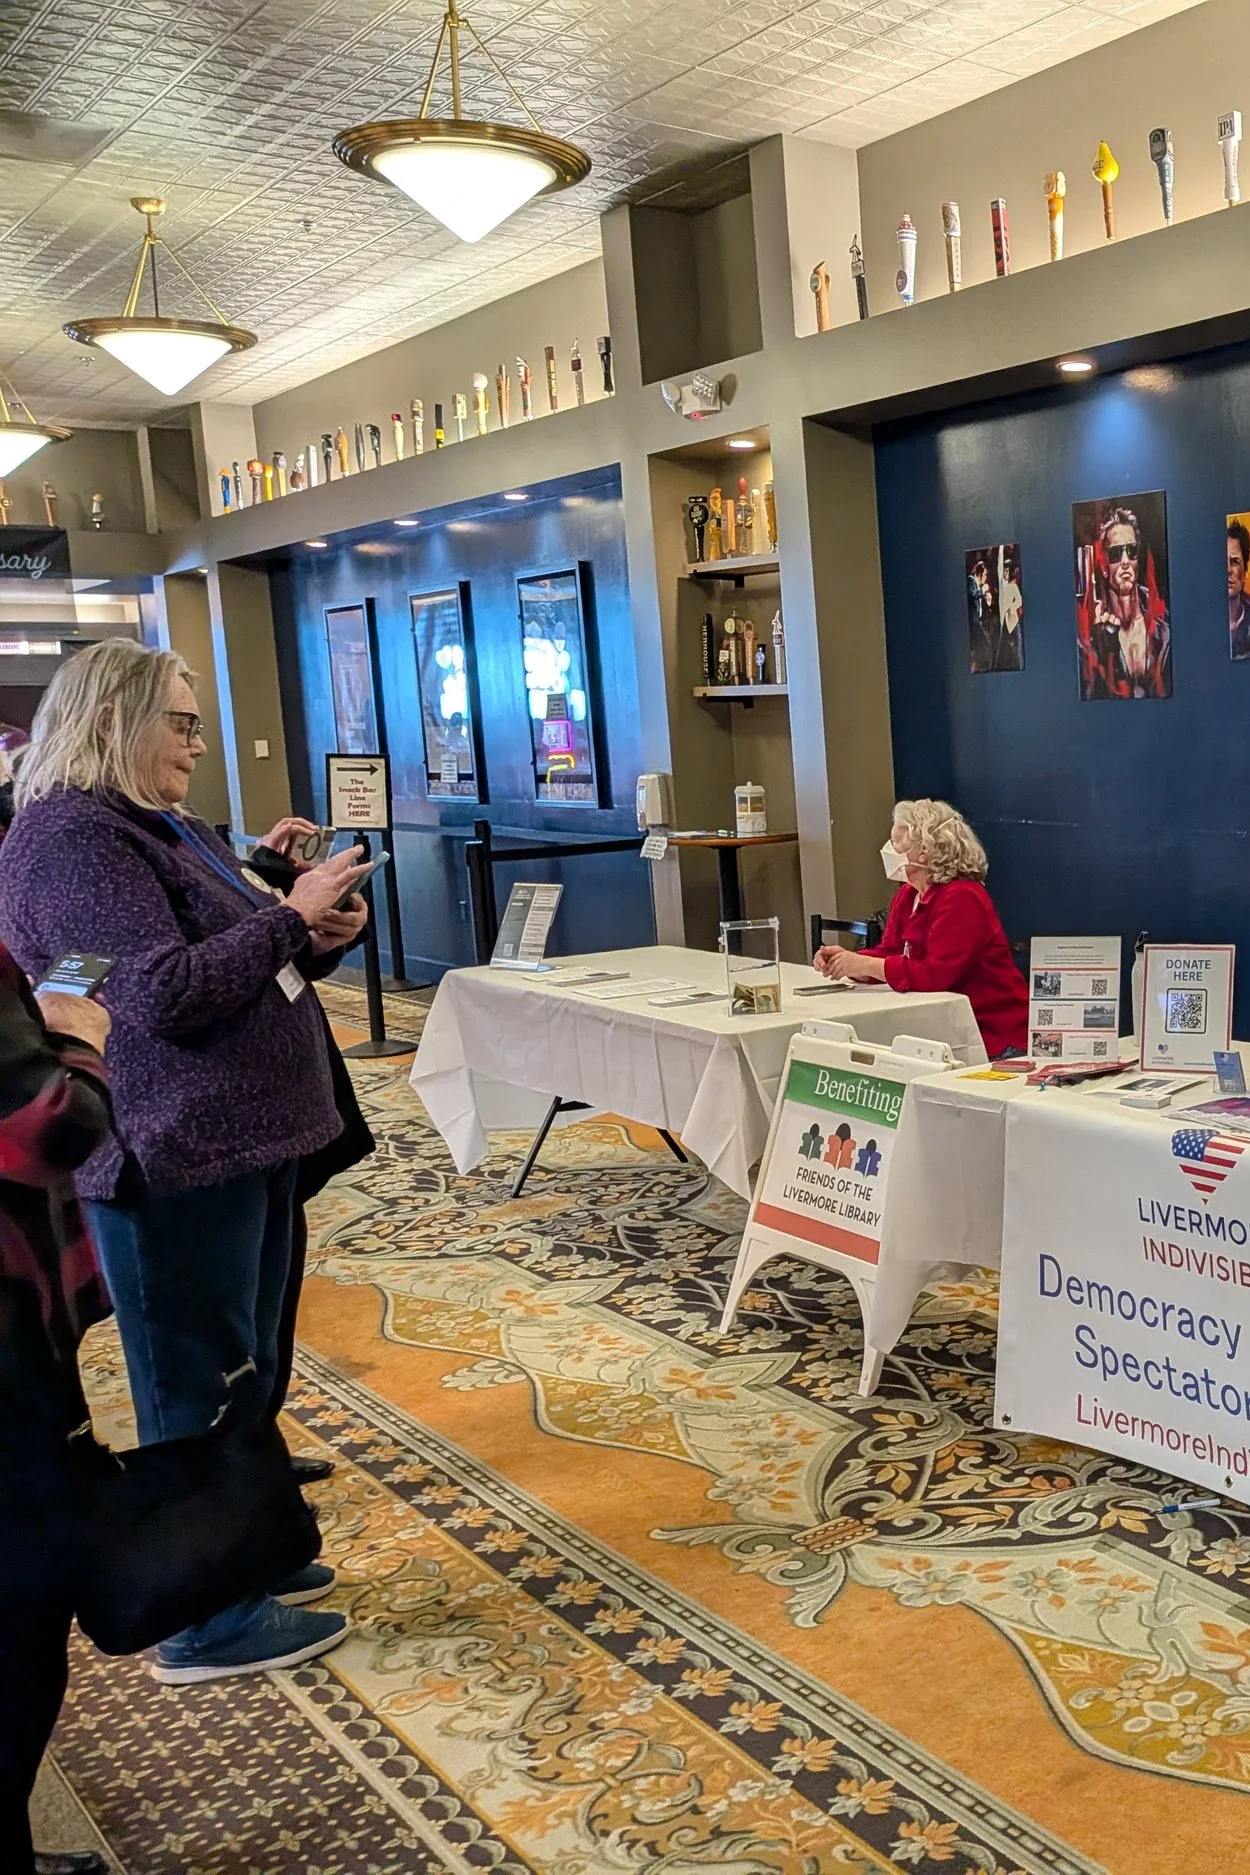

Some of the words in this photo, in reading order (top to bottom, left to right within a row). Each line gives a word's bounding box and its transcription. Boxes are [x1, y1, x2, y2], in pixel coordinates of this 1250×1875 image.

[1218, 118, 1234, 137] IPA
[1166, 958, 1212, 971] DONATE
[1173, 971, 1203, 982] HERE
[814, 1068, 902, 1122] Benefiting
[796, 1166, 835, 1191] FRIENDS
[837, 1178, 852, 1194] OF
[853, 1183, 873, 1201] THE
[783, 1184, 837, 1214] LIVERMORE
[838, 1202, 882, 1228] LIBRARY
[1038, 1253, 1241, 1361] Democracy
